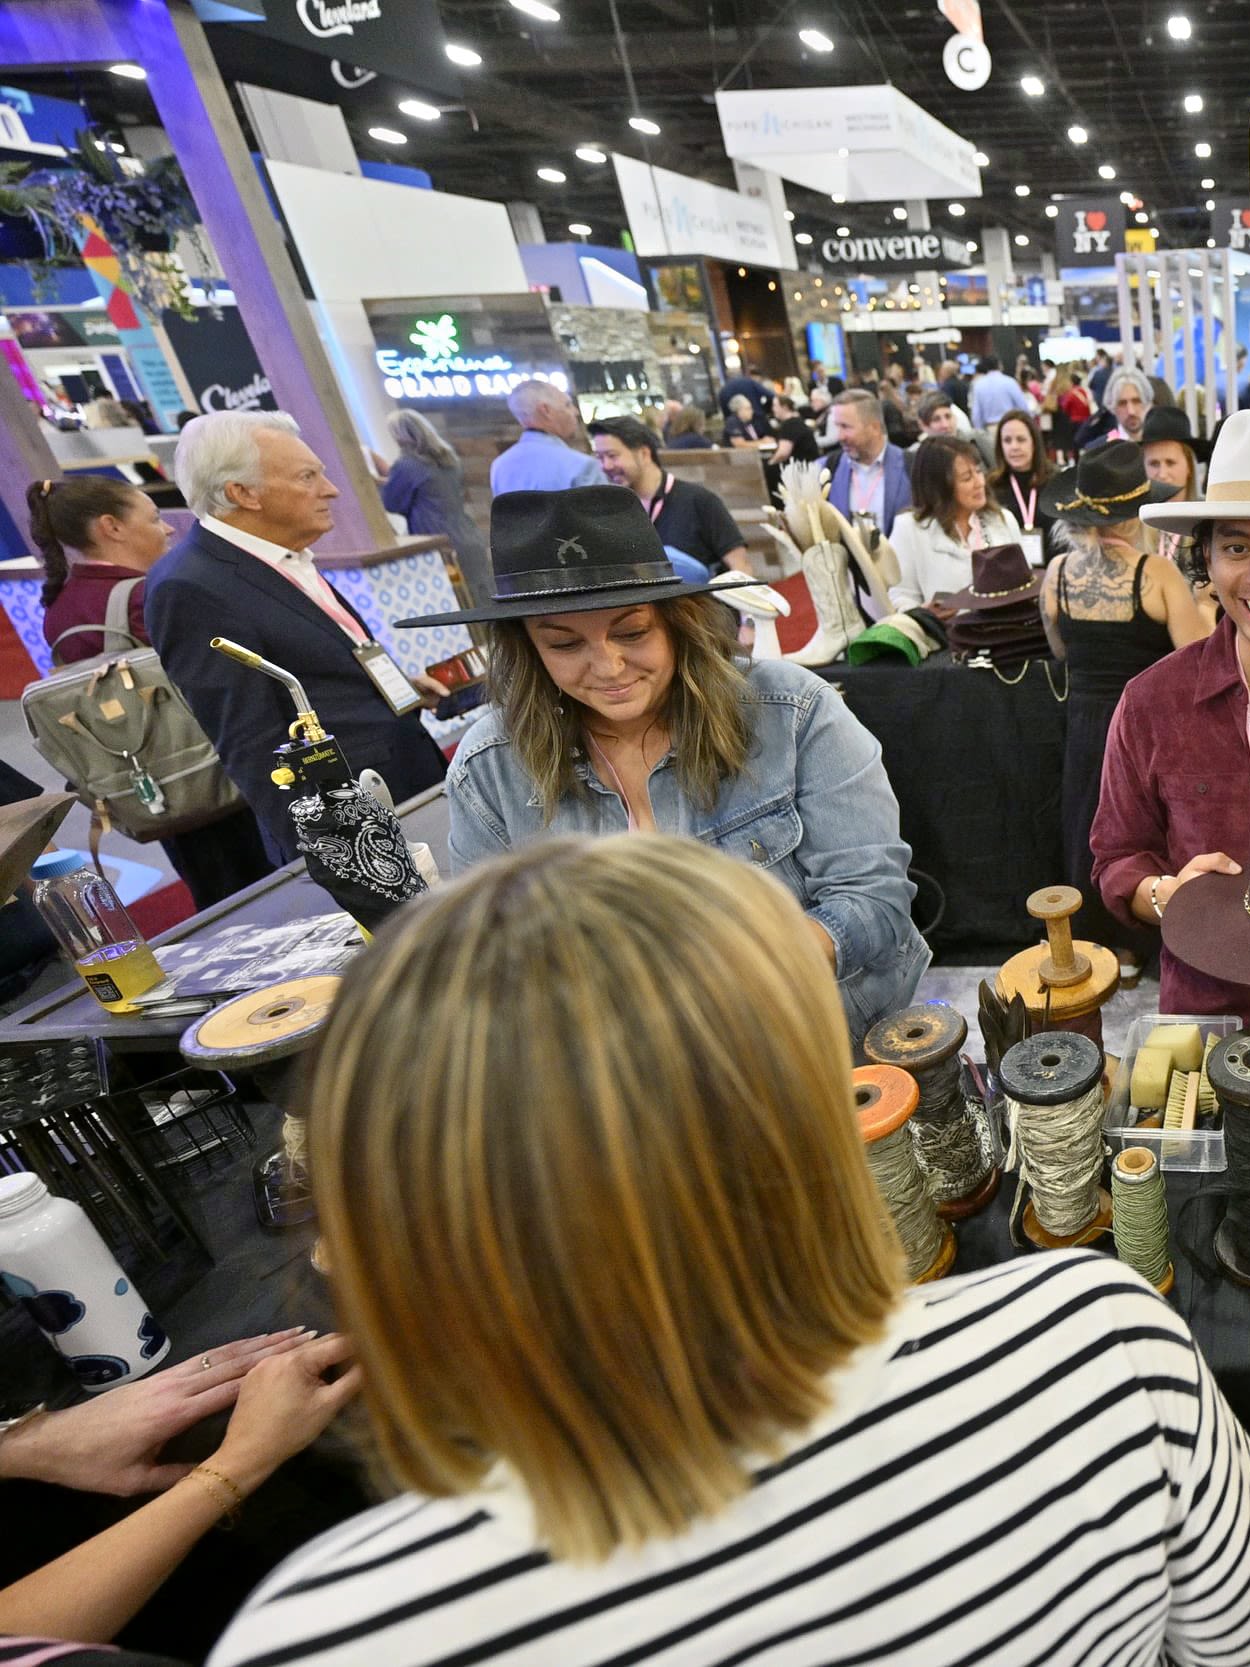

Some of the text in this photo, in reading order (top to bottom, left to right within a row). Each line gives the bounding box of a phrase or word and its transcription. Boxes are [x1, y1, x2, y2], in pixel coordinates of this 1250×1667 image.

[957, 47, 976, 73] C
[822, 234, 940, 263] convene
[1073, 230, 1111, 253] NY
[376, 350, 513, 382] Experience
[201, 373, 272, 416] Clevela
